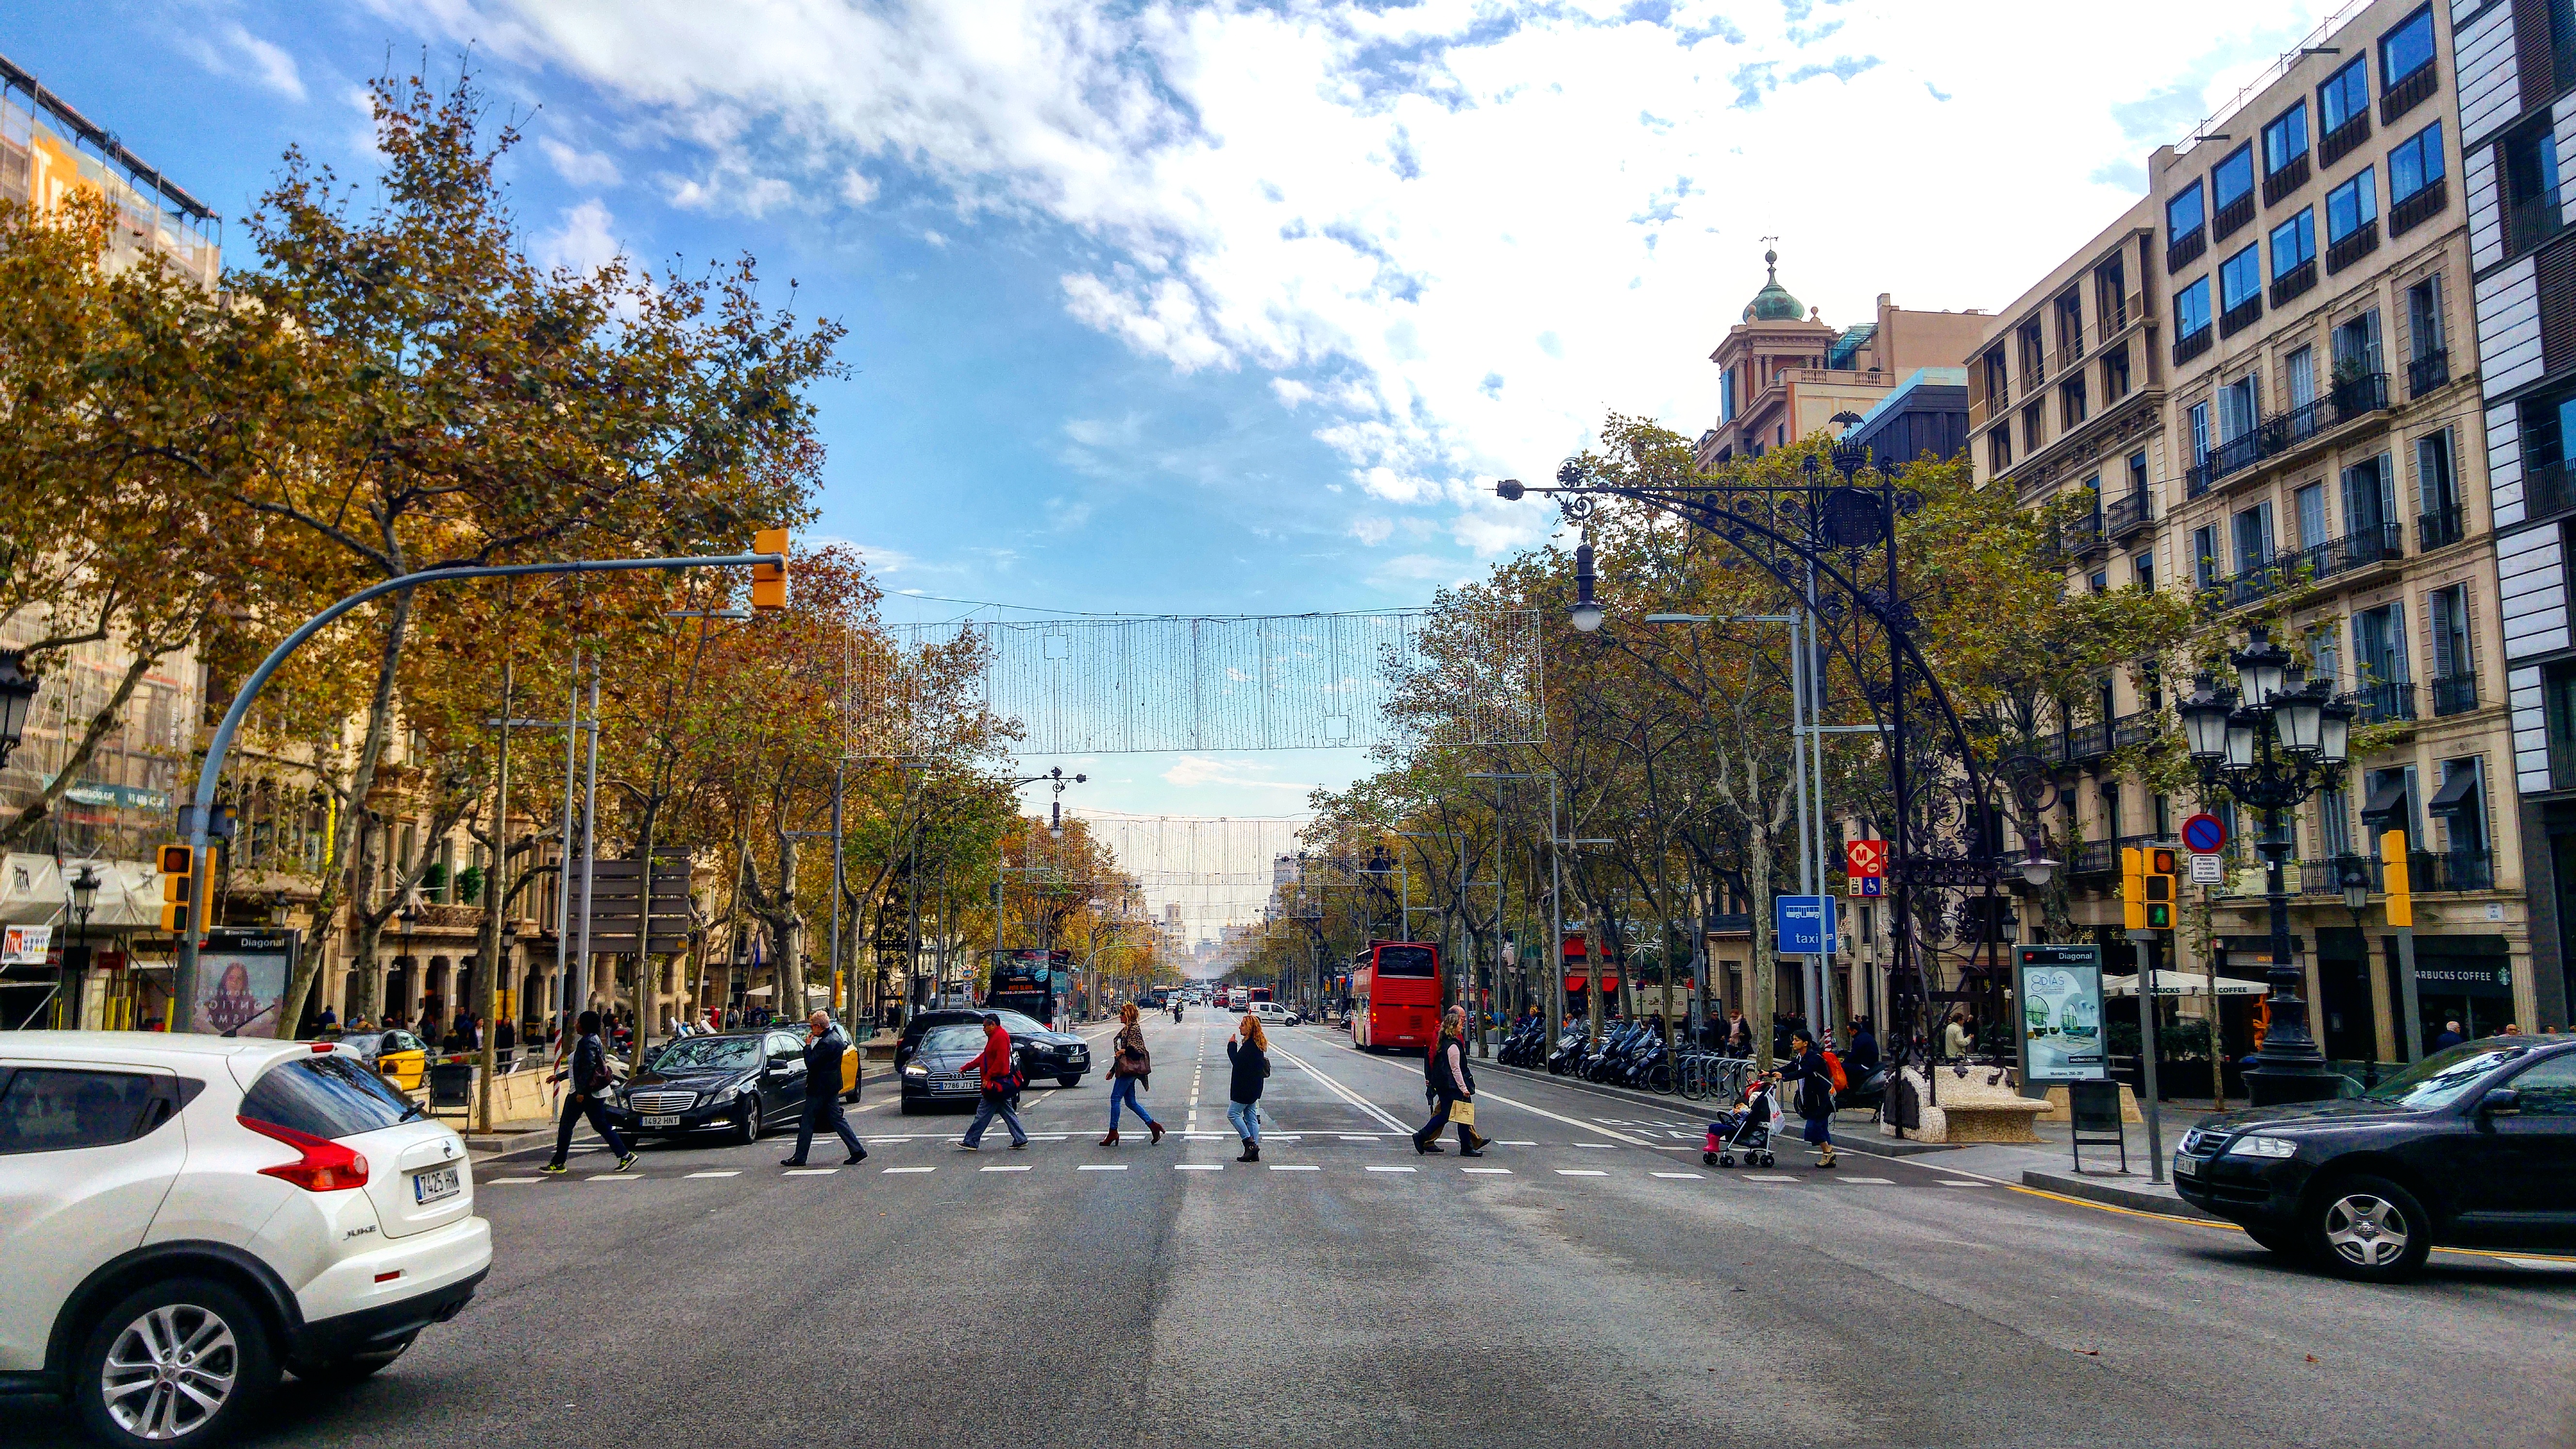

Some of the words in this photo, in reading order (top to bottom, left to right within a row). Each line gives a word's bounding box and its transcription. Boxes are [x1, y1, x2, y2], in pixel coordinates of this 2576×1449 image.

[1856, 849, 1867, 861] M
[241, 938, 285, 949] Diagonal
[1795, 933, 1819, 944] taxi
[2059, 952, 2092, 961] Diagonal
[2415, 971, 2455, 980] ARBUCKS
[2457, 971, 2491, 981] COFFEE
[421, 1173, 443, 1195] 7425
[343, 1224, 376, 1241] JUKE
